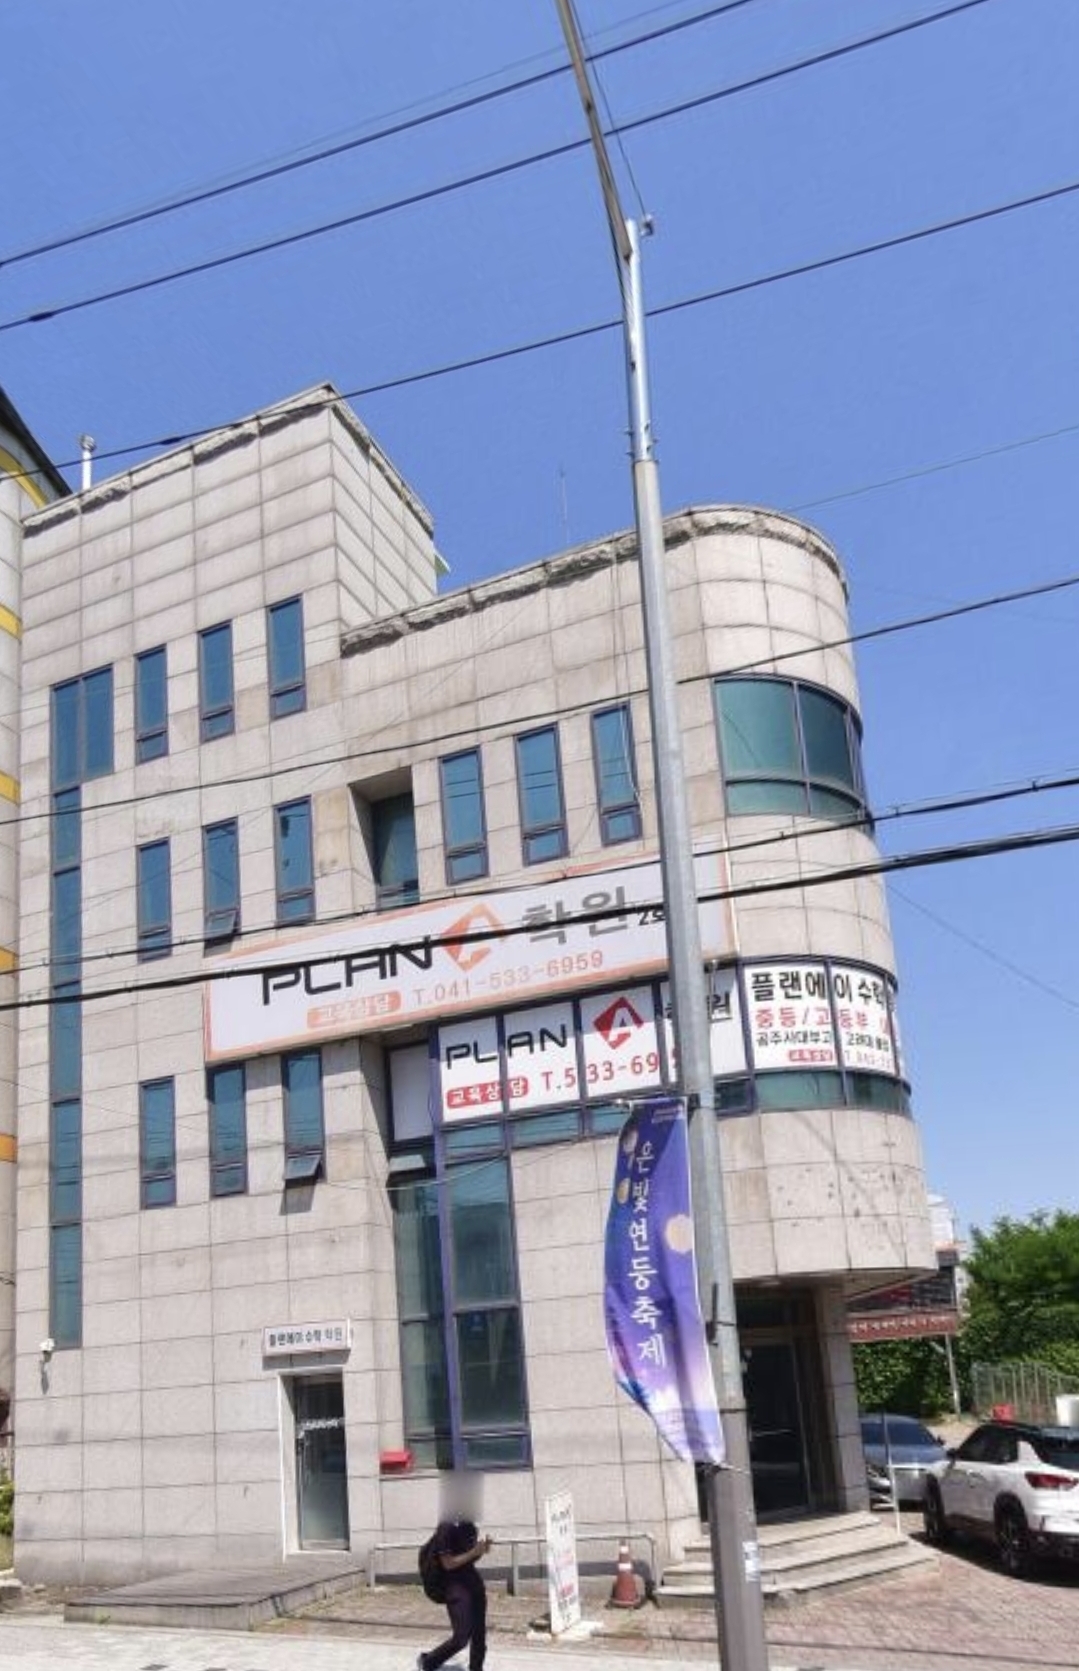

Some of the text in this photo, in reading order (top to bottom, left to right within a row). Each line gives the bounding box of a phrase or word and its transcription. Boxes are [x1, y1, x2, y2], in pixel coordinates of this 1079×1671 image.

[262, 935, 433, 1005] PLAN
[522, 886, 628, 944] 학원
[751, 971, 854, 1003] 플랜에이
[445, 1023, 568, 1070] PLAN
[448, 1076, 526, 1107] 교육상담
